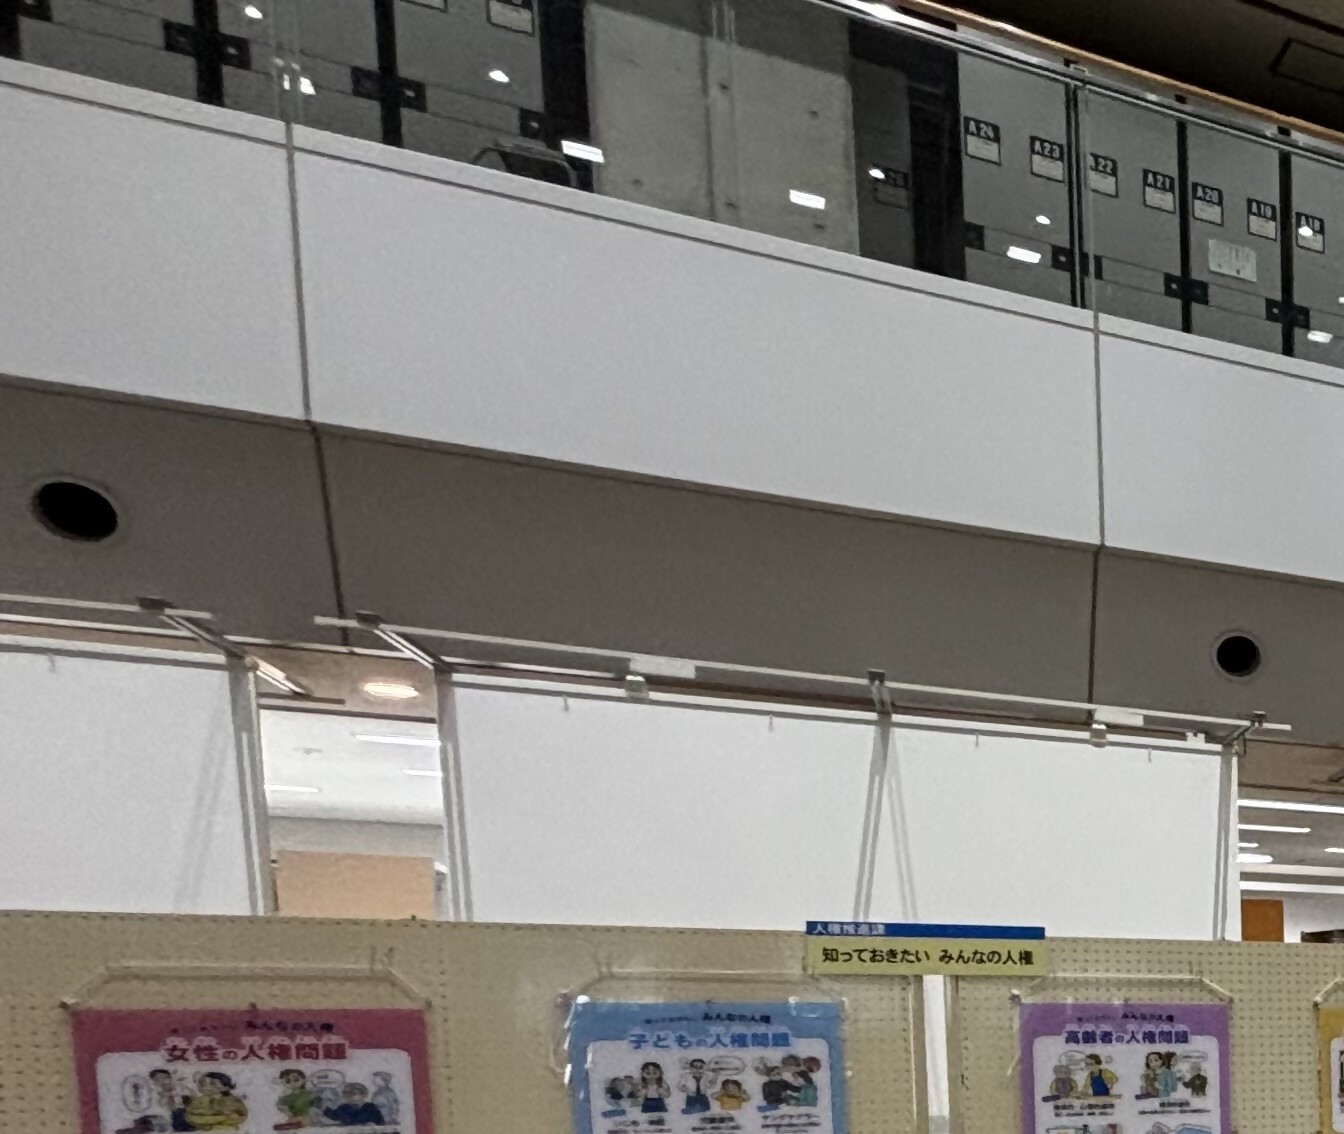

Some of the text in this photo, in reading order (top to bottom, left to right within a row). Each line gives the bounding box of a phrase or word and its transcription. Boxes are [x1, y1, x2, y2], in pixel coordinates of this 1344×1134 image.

[1034, 140, 1060, 158] A23
[1147, 171, 1170, 190] A21
[1196, 186, 1219, 203] A20
[822, 948, 1034, 966] 知っておきたい みんなの人権
[629, 1032, 791, 1050] 子どもの人権問題
[1064, 1030, 1190, 1044] 高齢者の人権問題
[165, 1043, 347, 1062] 女性の人権問題
